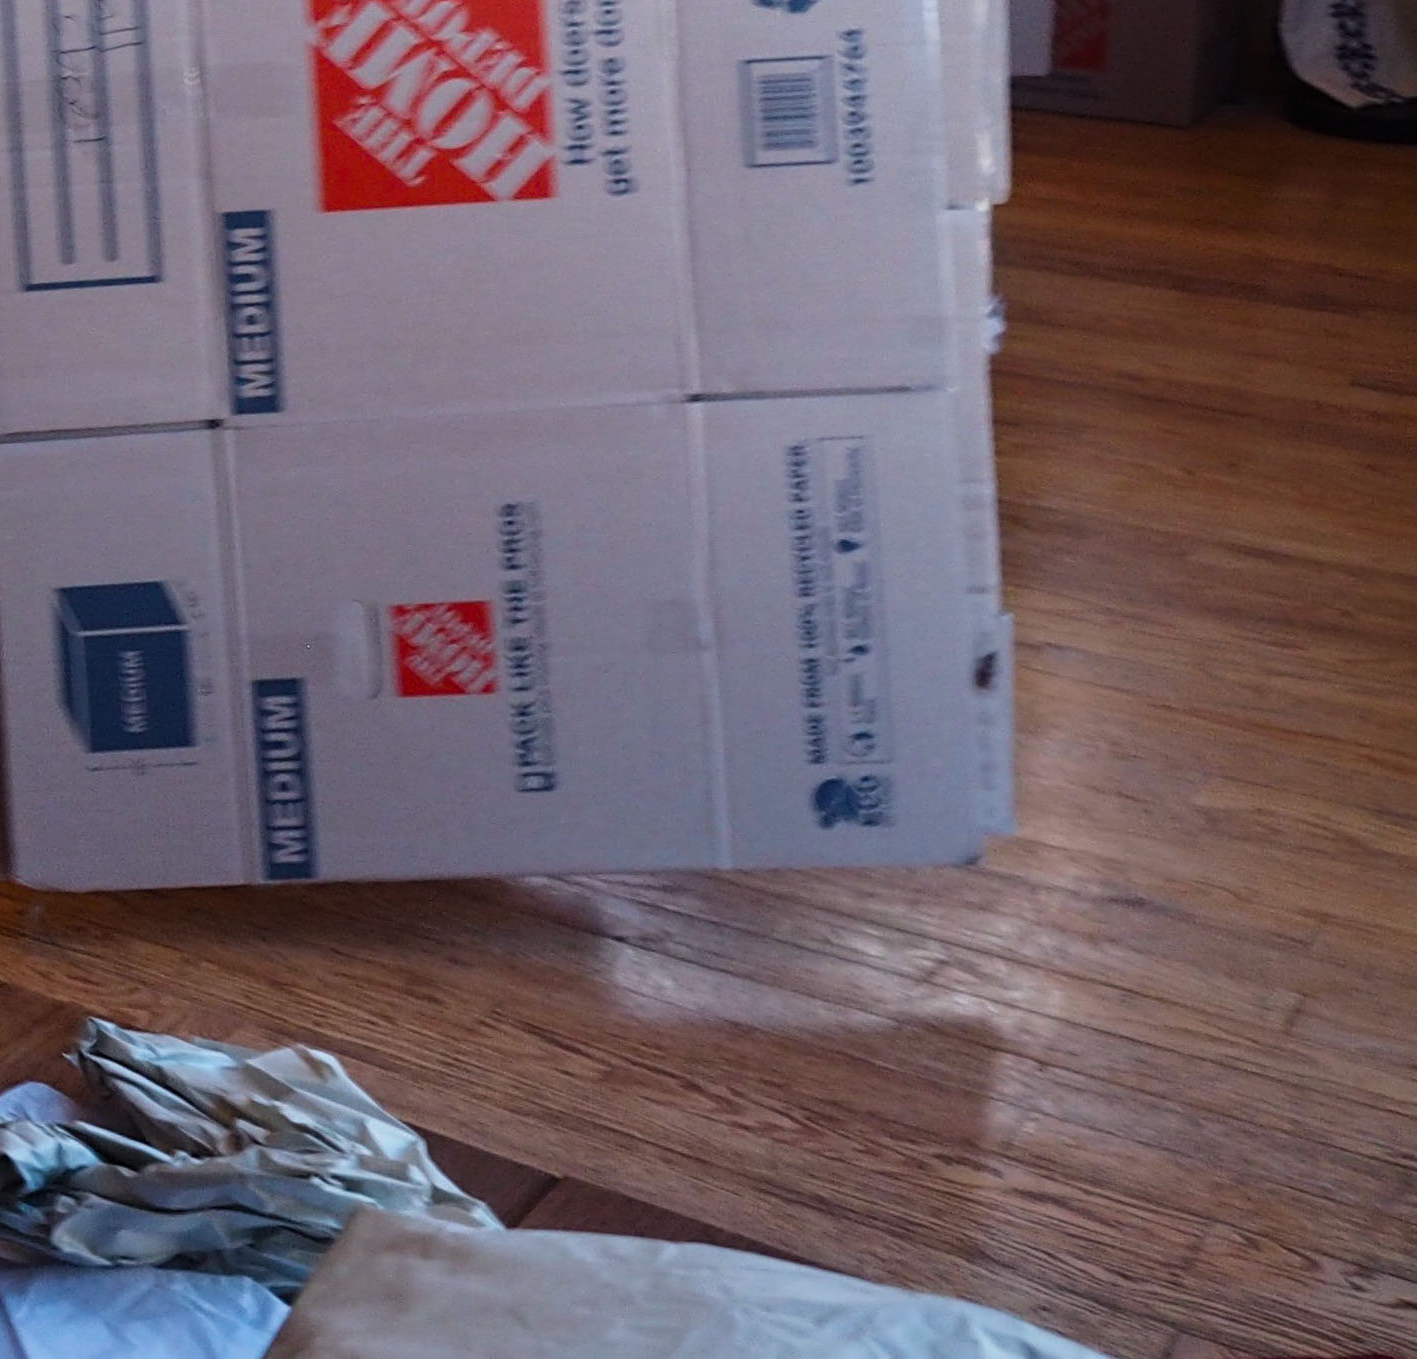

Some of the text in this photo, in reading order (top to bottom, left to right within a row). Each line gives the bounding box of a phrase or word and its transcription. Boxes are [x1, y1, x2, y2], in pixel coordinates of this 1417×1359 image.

[561, 98, 596, 167] How
[598, 57, 631, 136] more
[332, 97, 437, 187] THE
[603, 146, 639, 197] get
[227, 227, 277, 399] MEDIUM
[117, 649, 150, 734] MEDIUM
[260, 694, 310, 865] MEDIUM
